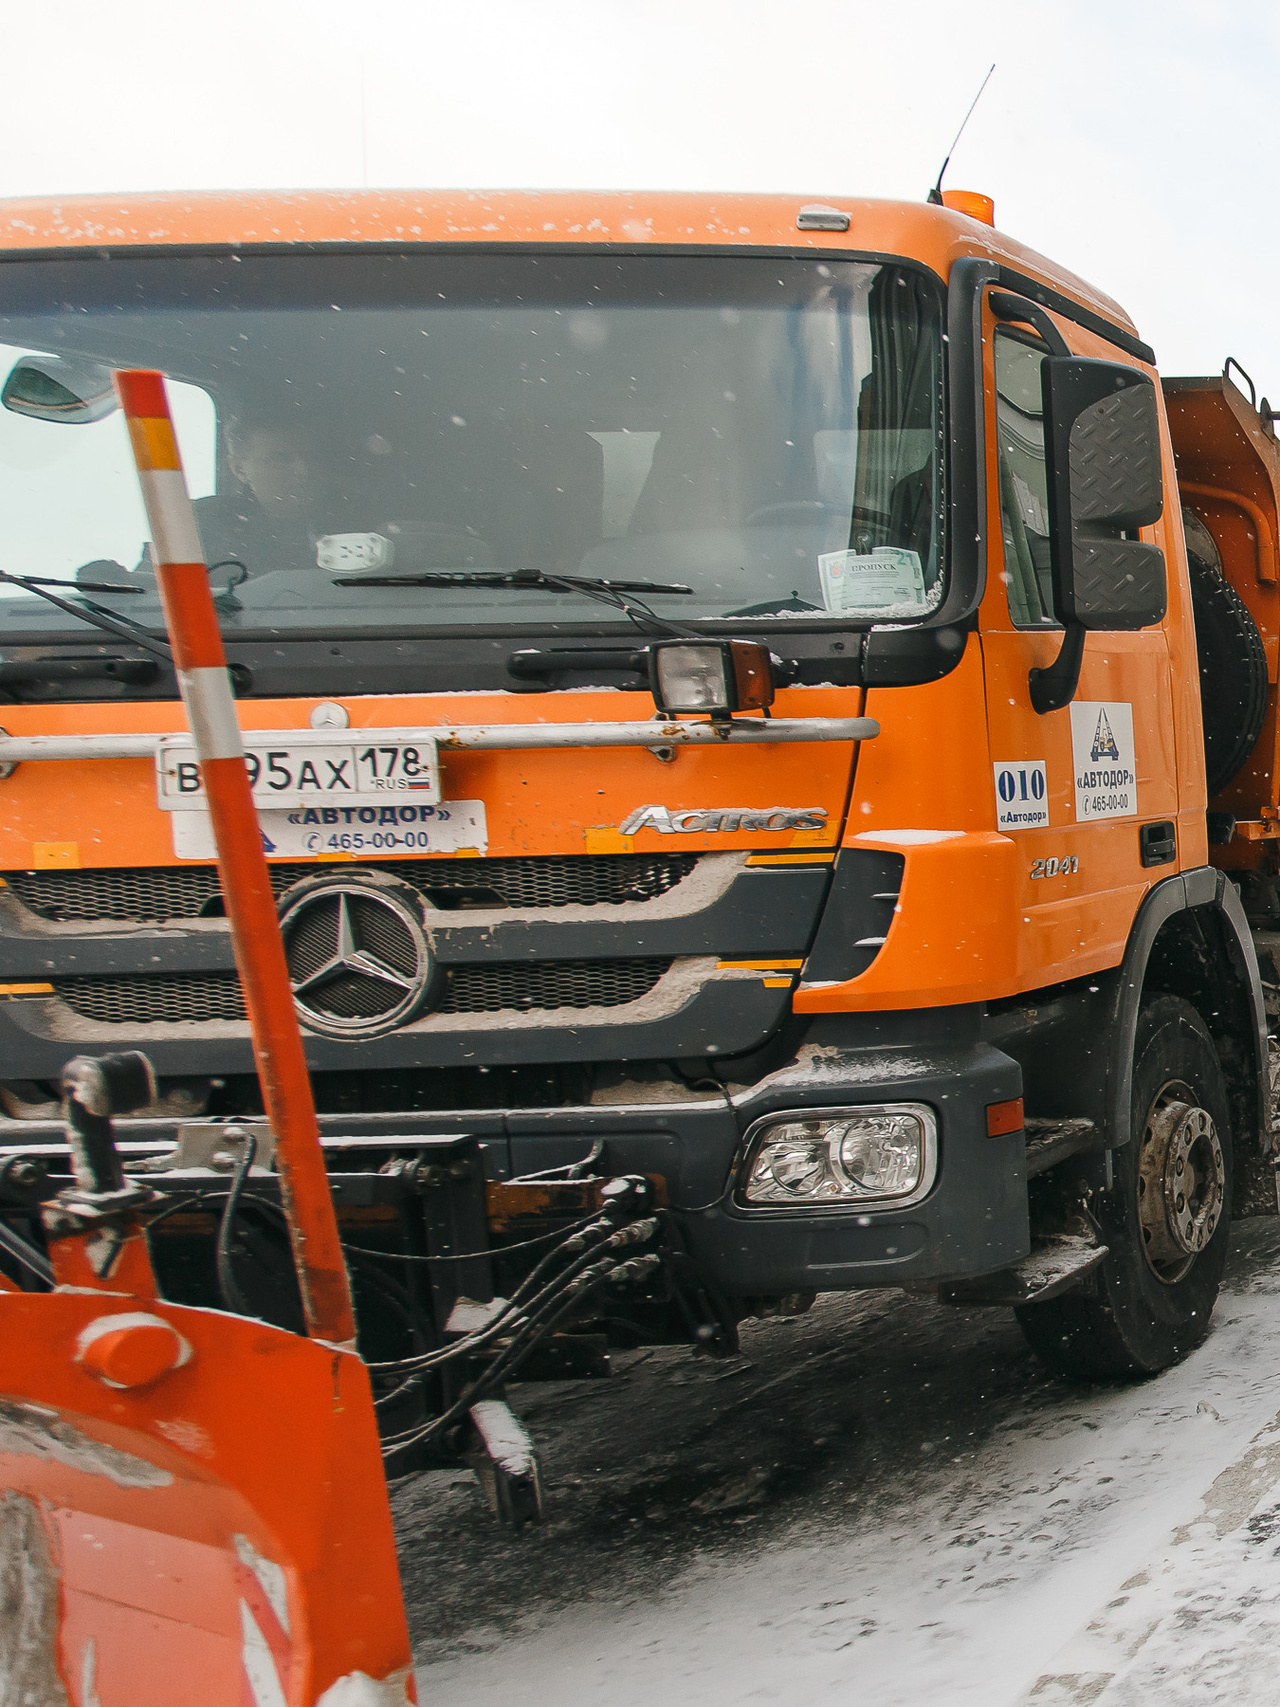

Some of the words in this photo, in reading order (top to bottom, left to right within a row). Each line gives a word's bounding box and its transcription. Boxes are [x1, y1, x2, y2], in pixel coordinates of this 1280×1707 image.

[851, 563, 897, 572] ПРОПУСК
[359, 747, 420, 778] 178
[375, 778, 407, 790] RUS
[998, 769, 1045, 803] 010
[1077, 769, 1134, 790] «АВТОДОР»
[1092, 793, 1128, 812] 465-00-00
[327, 832, 429, 849] 465-00-00
[1030, 854, 1079, 880] 2041
